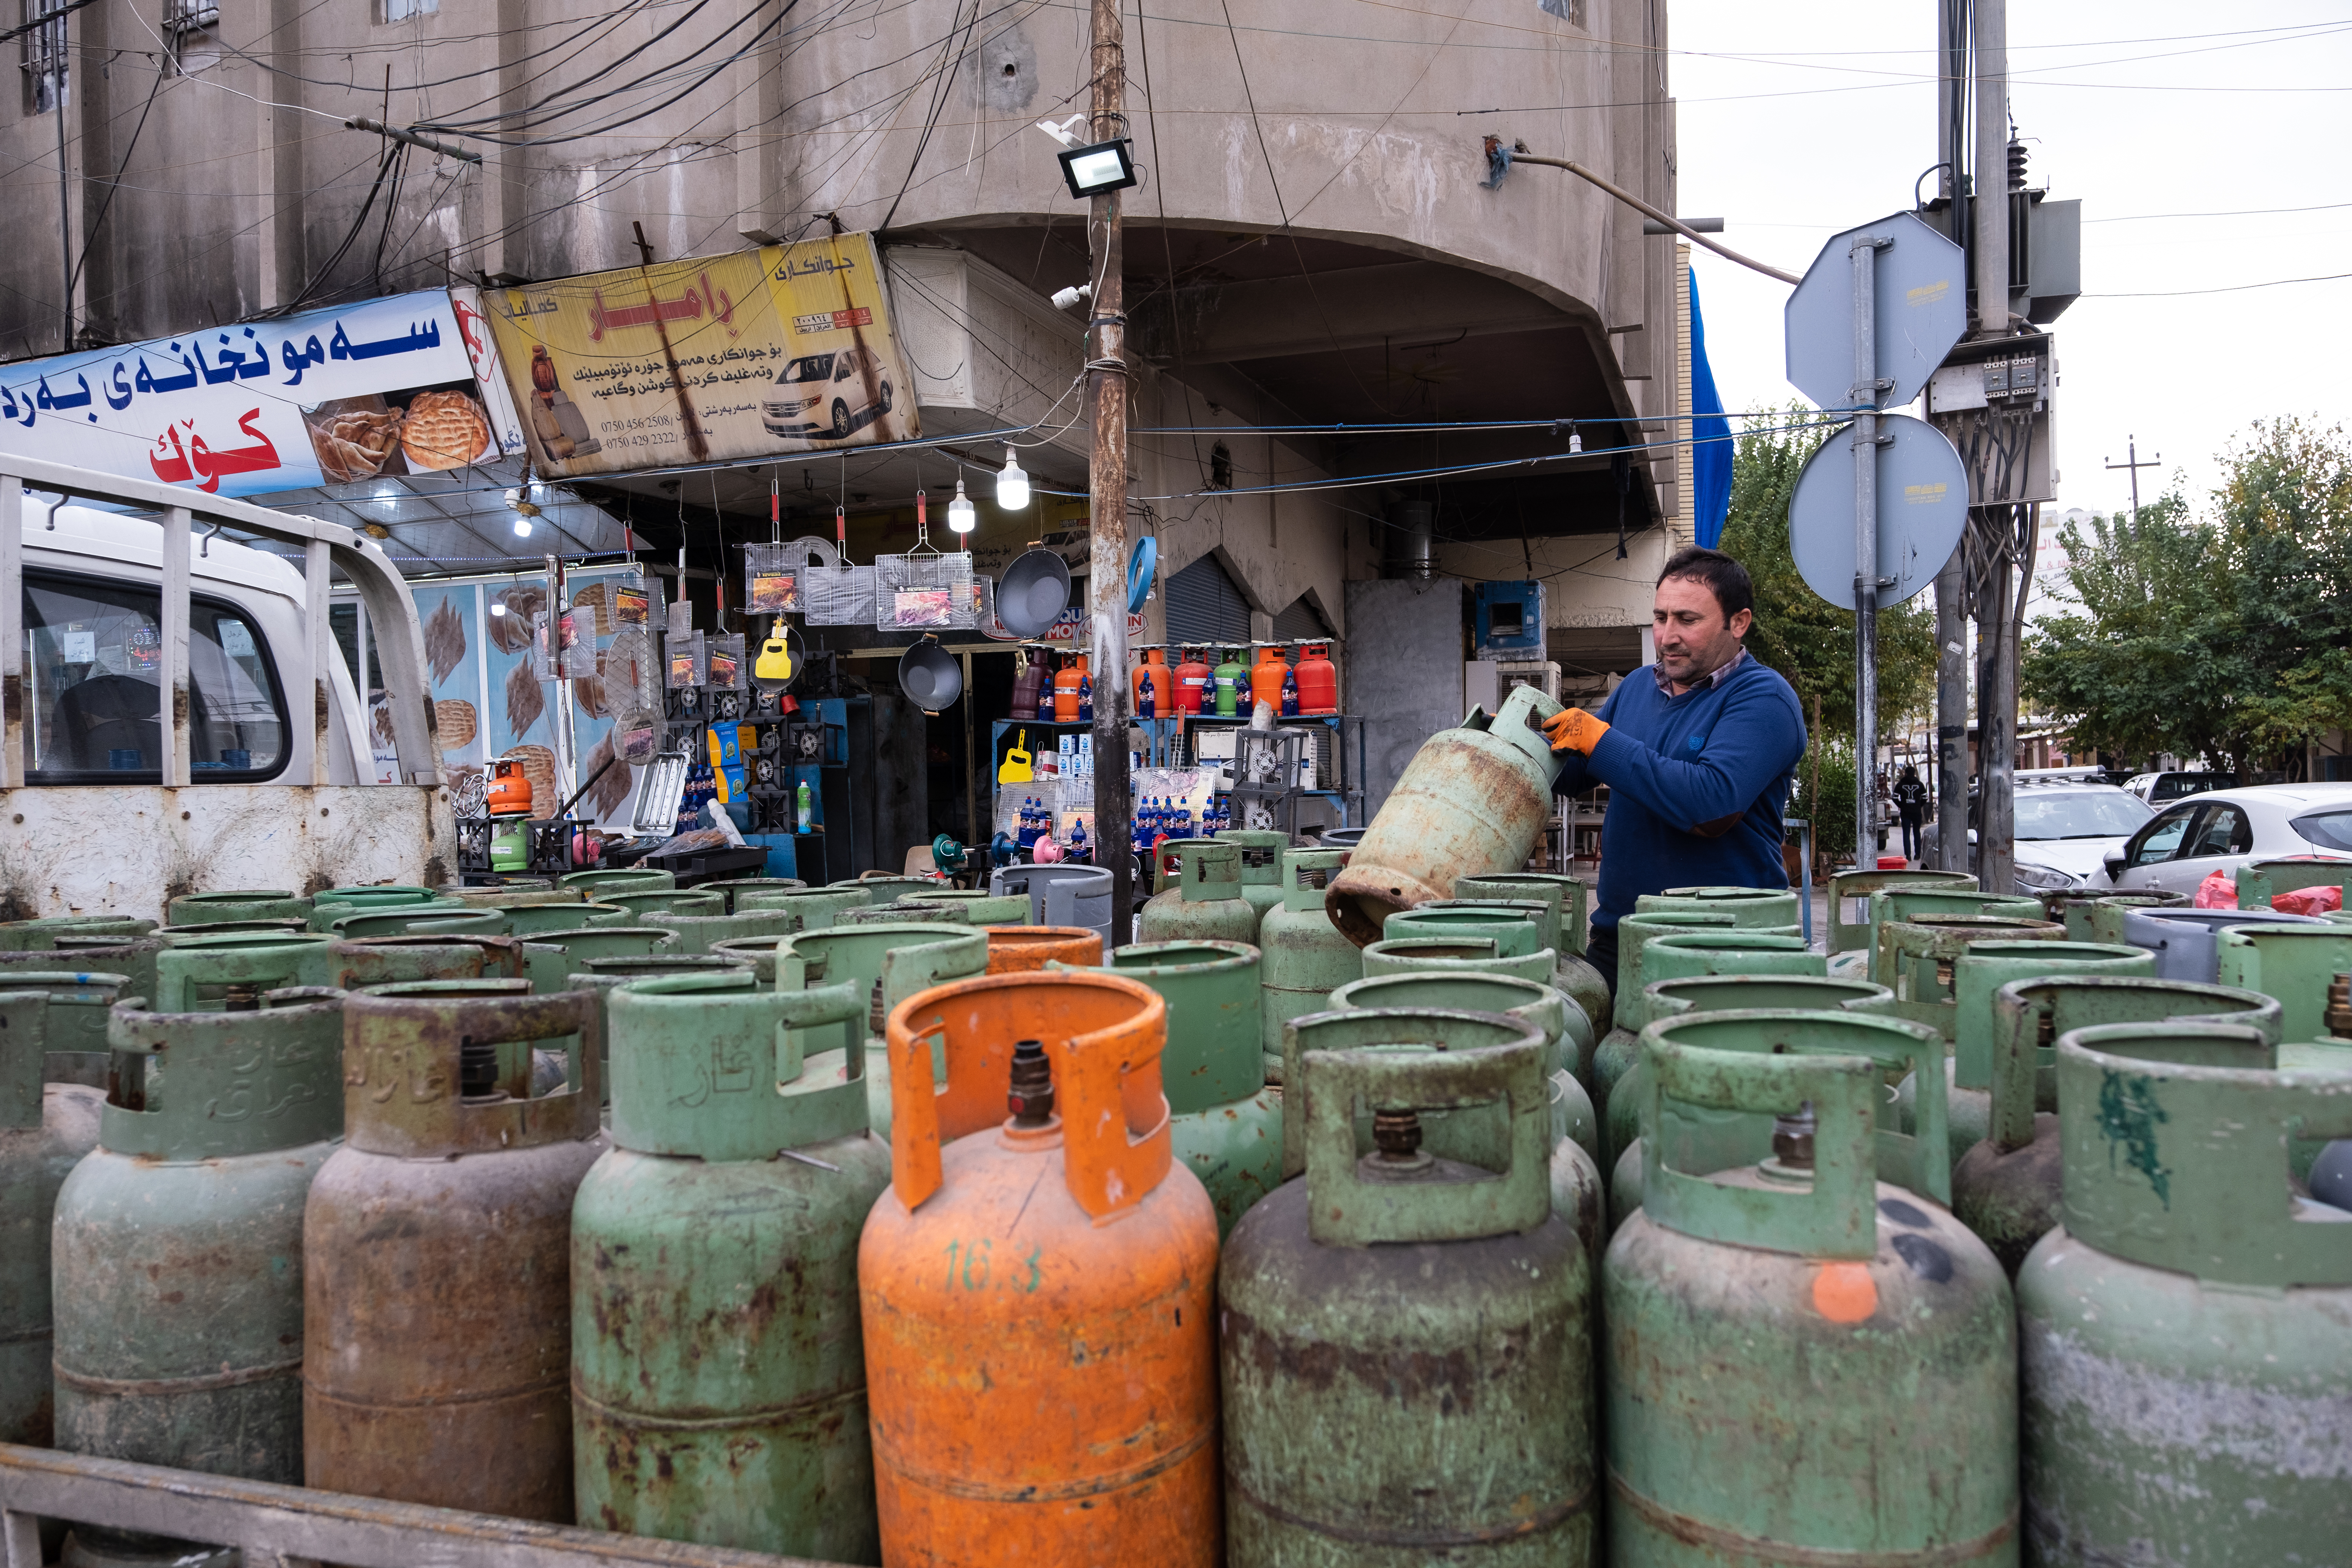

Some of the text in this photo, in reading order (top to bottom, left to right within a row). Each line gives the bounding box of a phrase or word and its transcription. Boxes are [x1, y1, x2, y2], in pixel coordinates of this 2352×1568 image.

[0, 372, 98, 428] بەرد
[601, 420, 624, 433] 0750
[626, 418, 645, 429] 456
[606, 436, 629, 449] 0750
[632, 435, 649, 446] 429
[1902, 785, 1919, 799] Y
